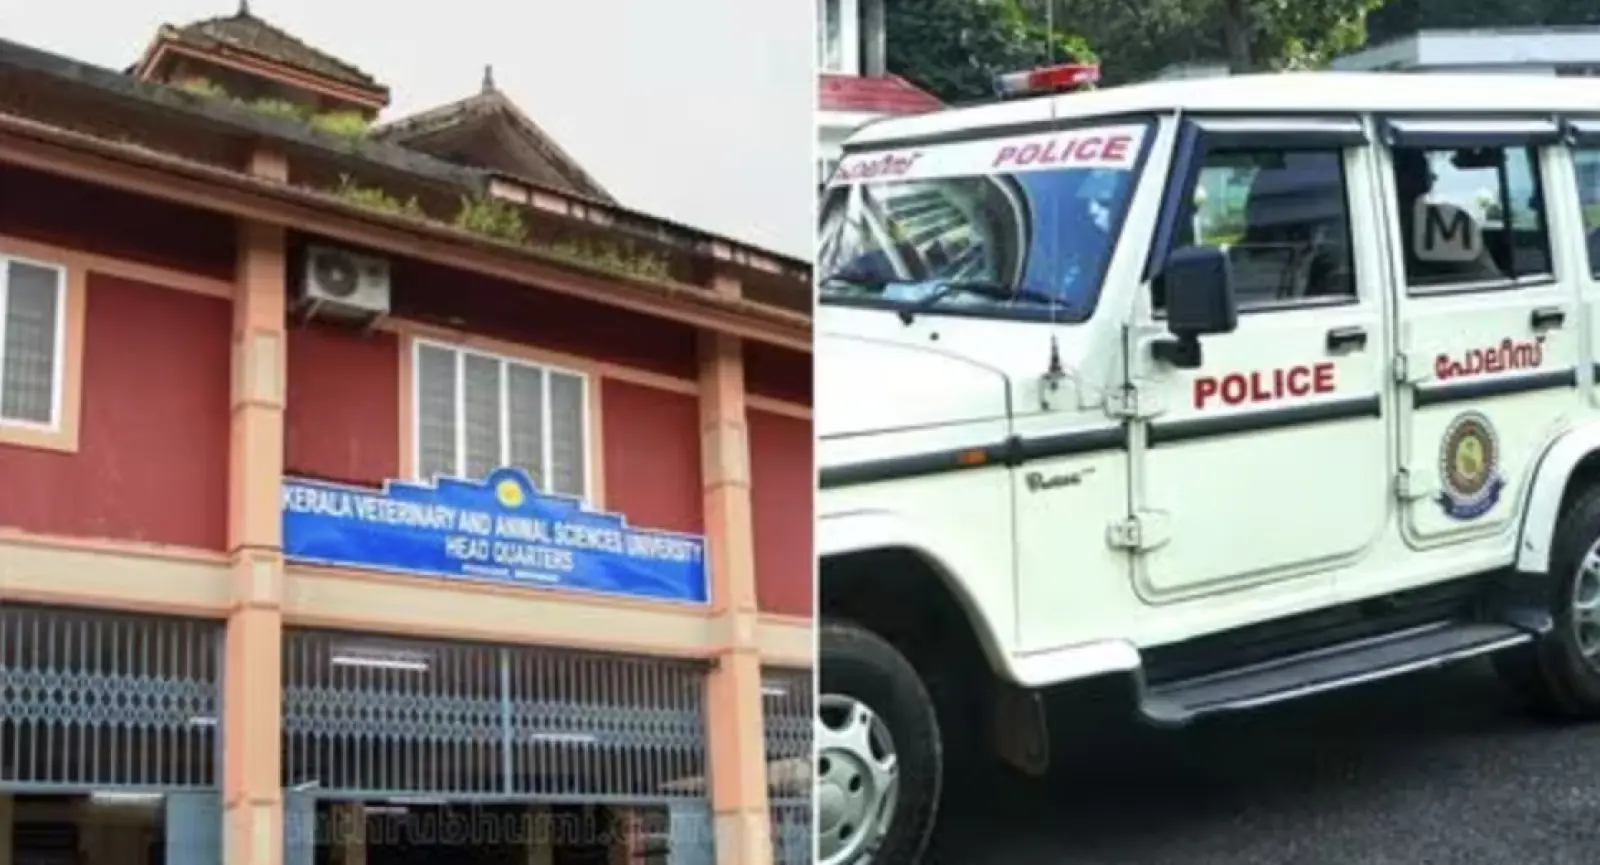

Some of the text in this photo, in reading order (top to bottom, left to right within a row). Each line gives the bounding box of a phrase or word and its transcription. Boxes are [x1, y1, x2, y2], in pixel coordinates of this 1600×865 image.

[992, 135, 1132, 167] POLICE
[1435, 335, 1546, 379] പോലീസ്
[1194, 363, 1335, 409] POLICE
[282, 485, 353, 518] KERALA
[355, 495, 456, 529] VETERINARY
[458, 510, 491, 536] AND
[495, 516, 553, 544] ANIMAL
[445, 534, 574, 572] HEAD QUARTERS
